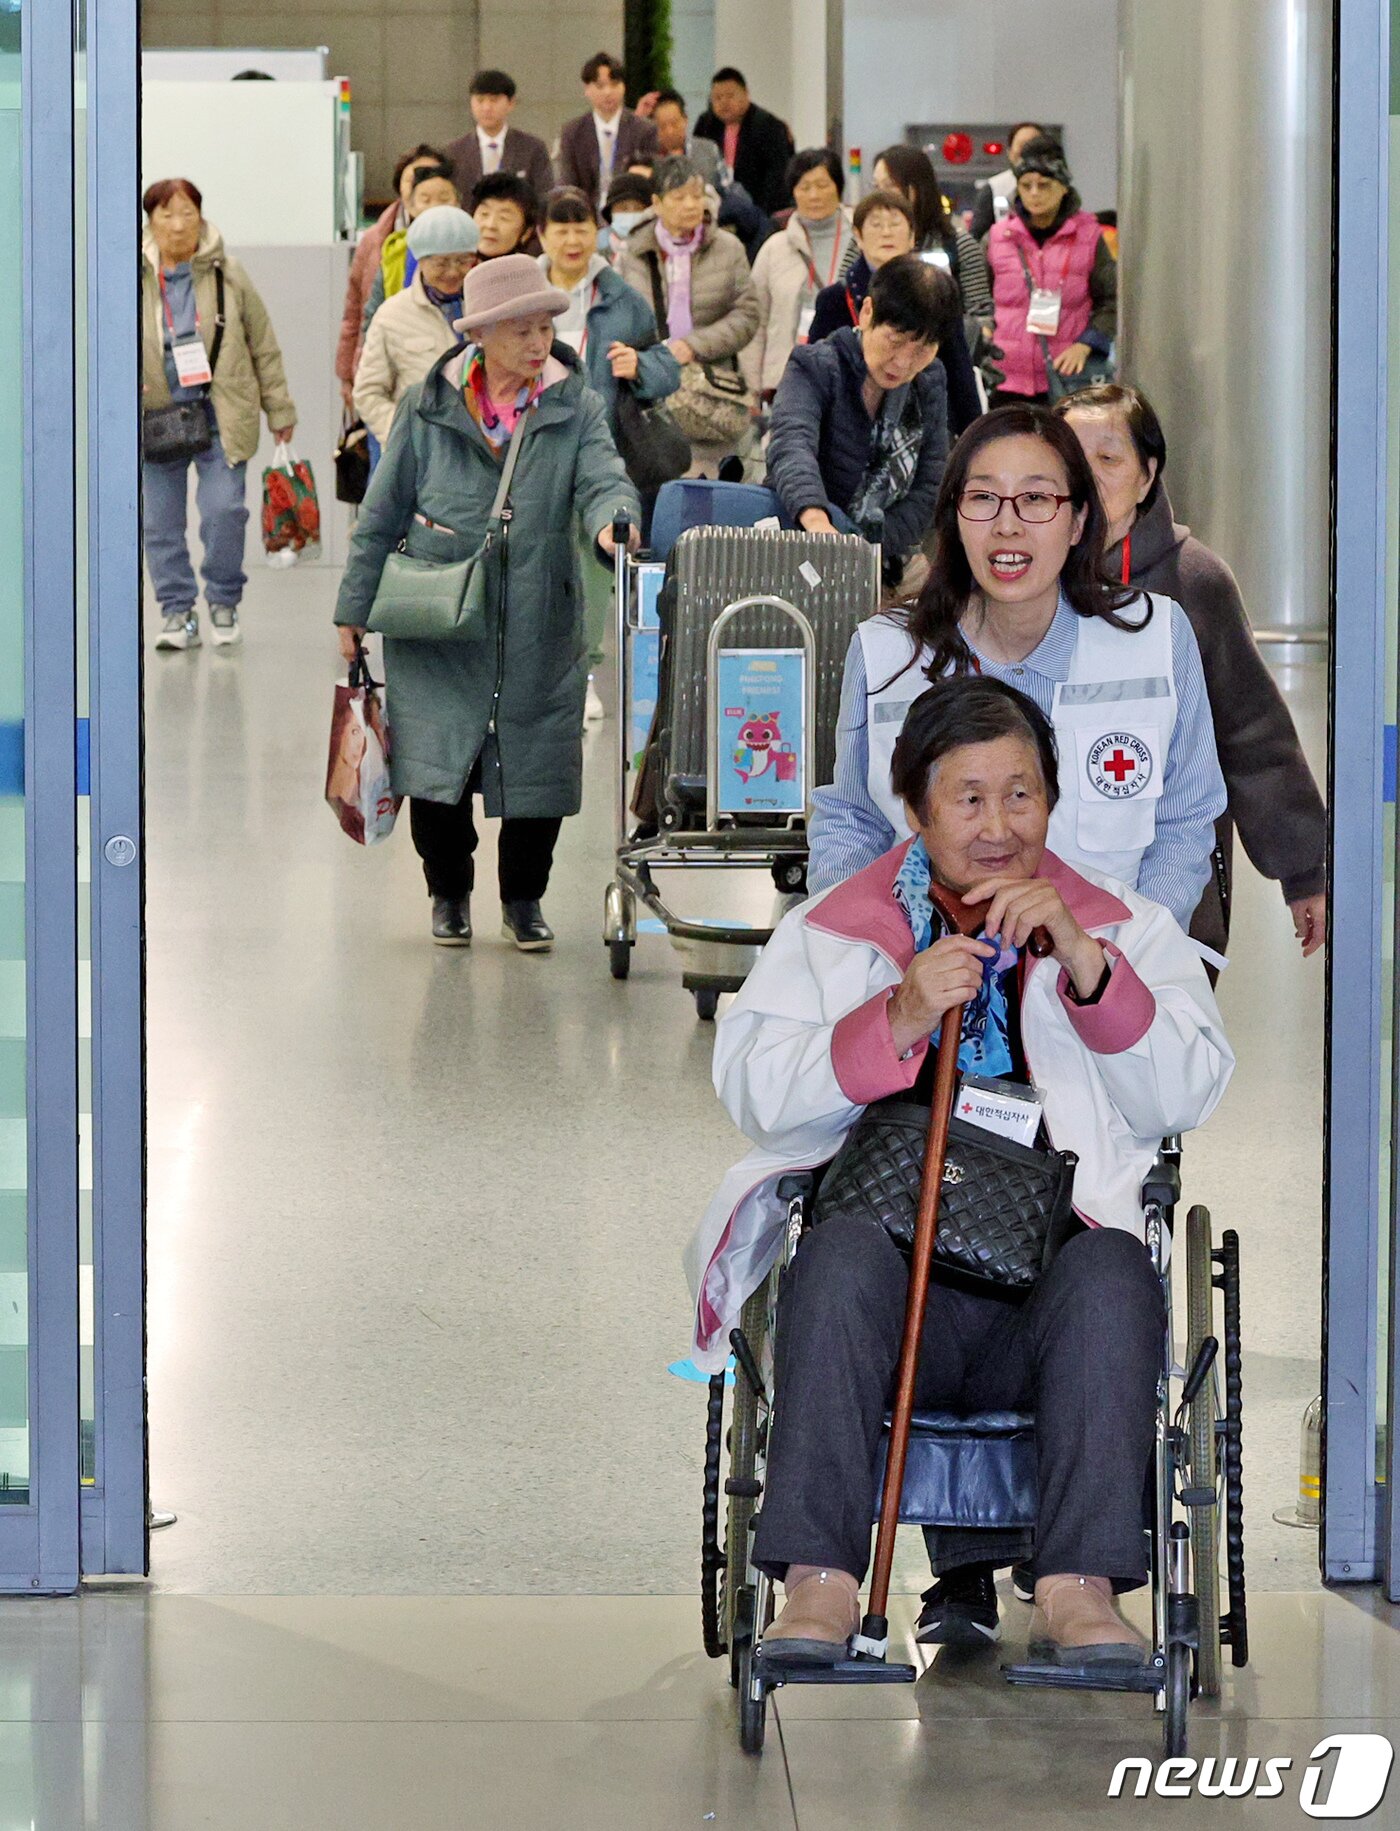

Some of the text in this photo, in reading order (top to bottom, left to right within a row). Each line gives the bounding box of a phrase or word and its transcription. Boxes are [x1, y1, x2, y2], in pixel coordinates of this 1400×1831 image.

[1091, 735, 1148, 765] KOREAN RED CROSS
[1095, 773, 1147, 796] 대한적십자사
[975, 1105, 1029, 1124] 대한적십자사
